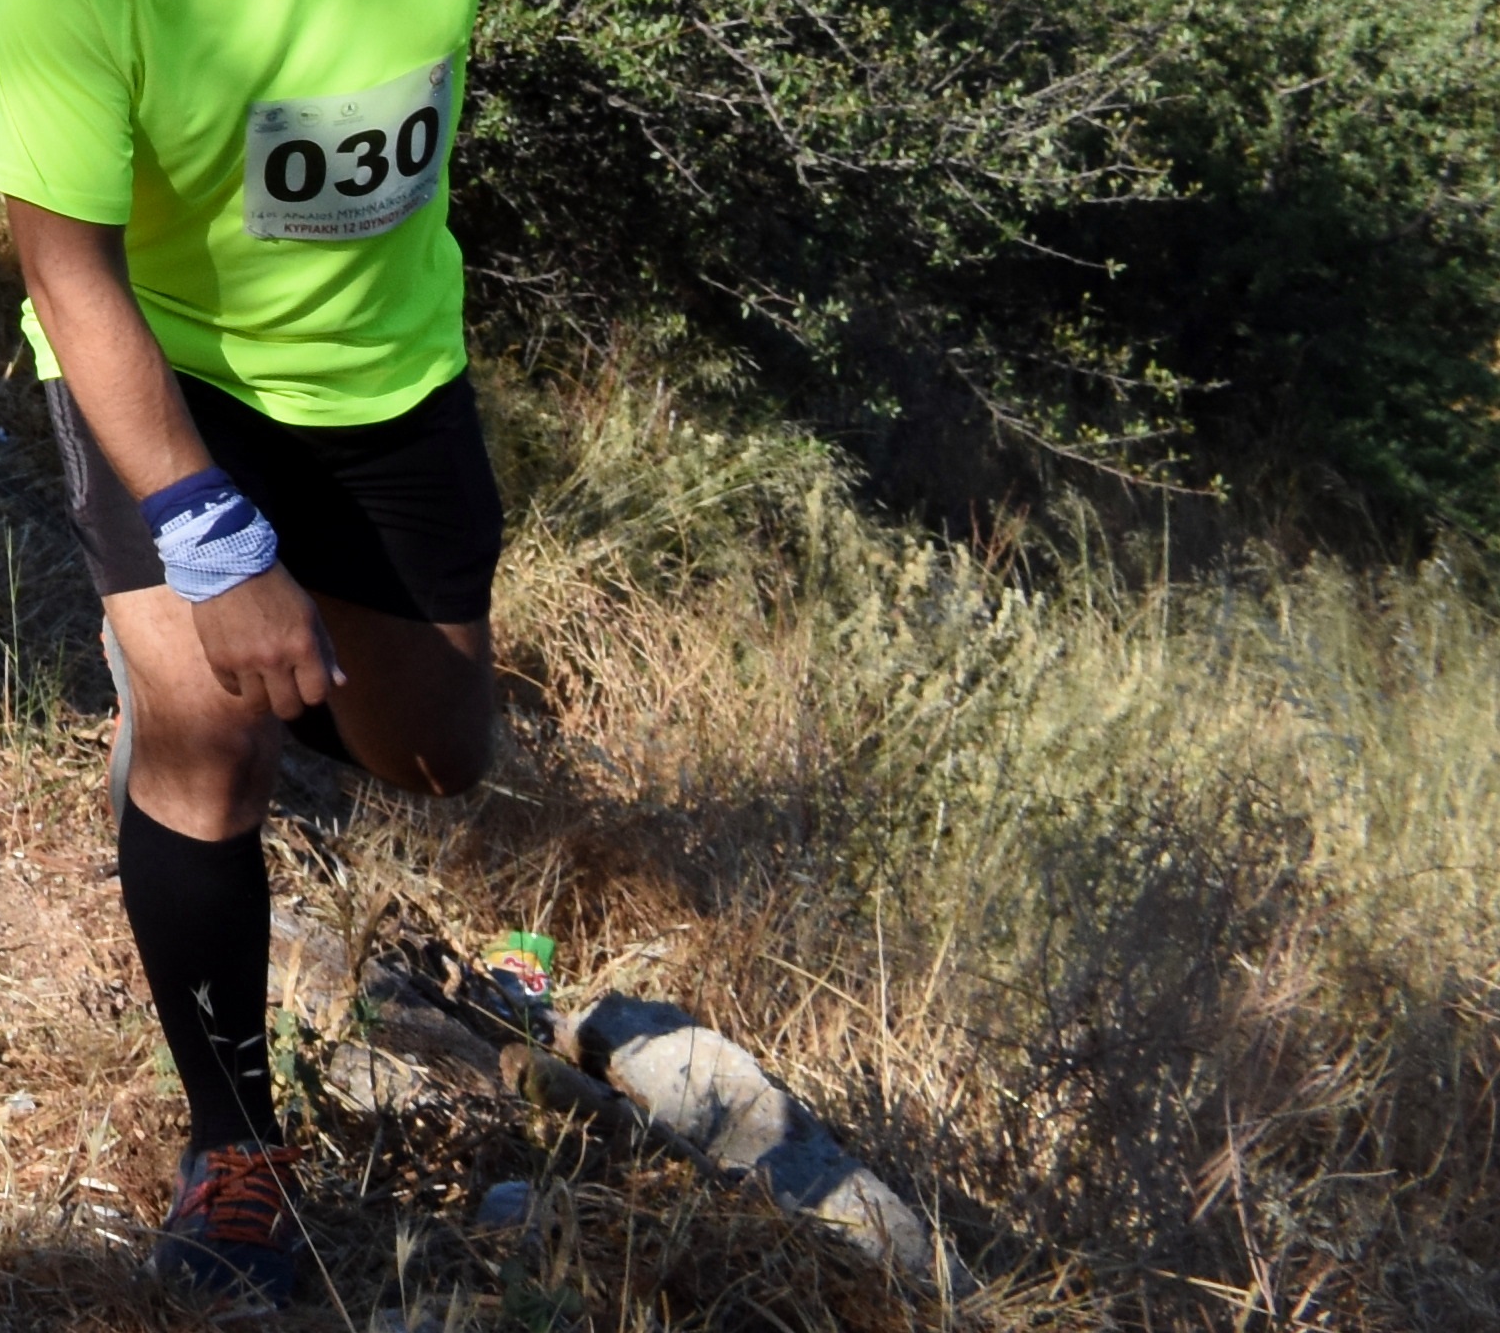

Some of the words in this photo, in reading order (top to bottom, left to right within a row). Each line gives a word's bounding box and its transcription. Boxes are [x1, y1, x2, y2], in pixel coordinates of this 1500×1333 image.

[264, 106, 439, 203] 030
[284, 223, 339, 234] ΚΥΡΙΑΚΗ
[344, 222, 355, 233] 12
